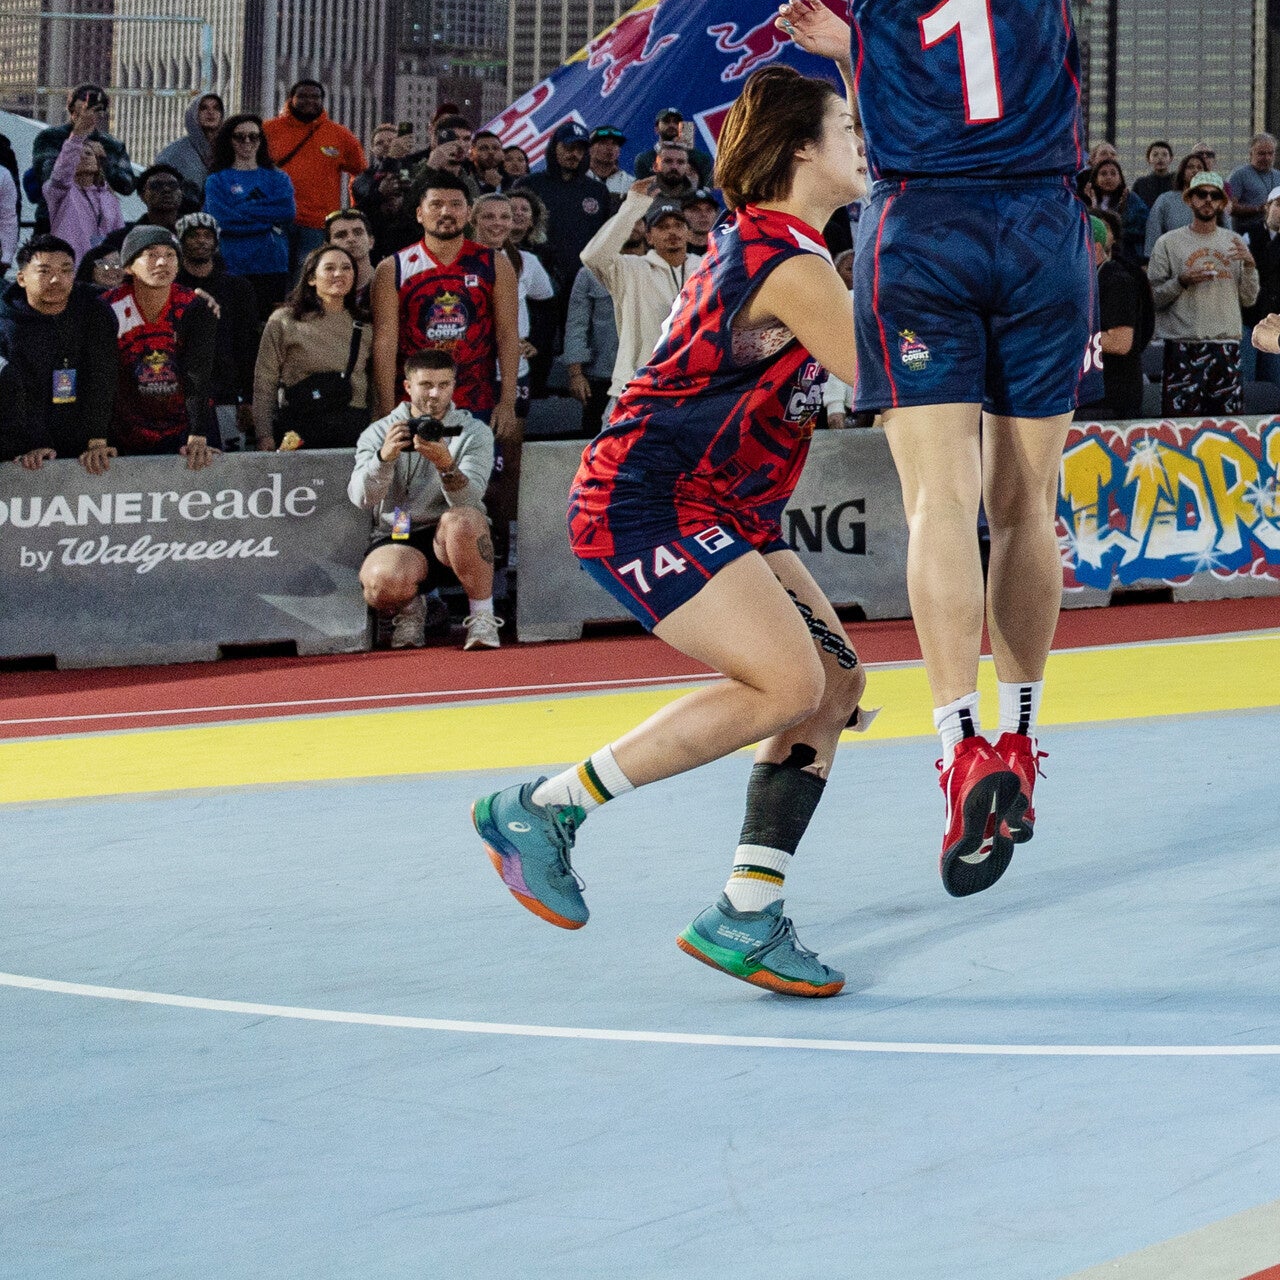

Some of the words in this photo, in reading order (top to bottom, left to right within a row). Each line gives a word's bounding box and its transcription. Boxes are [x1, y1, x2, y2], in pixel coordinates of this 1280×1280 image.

[20, 546, 53, 571] by
[57, 534, 280, 575] Walgreens
[617, 544, 687, 594] 74
